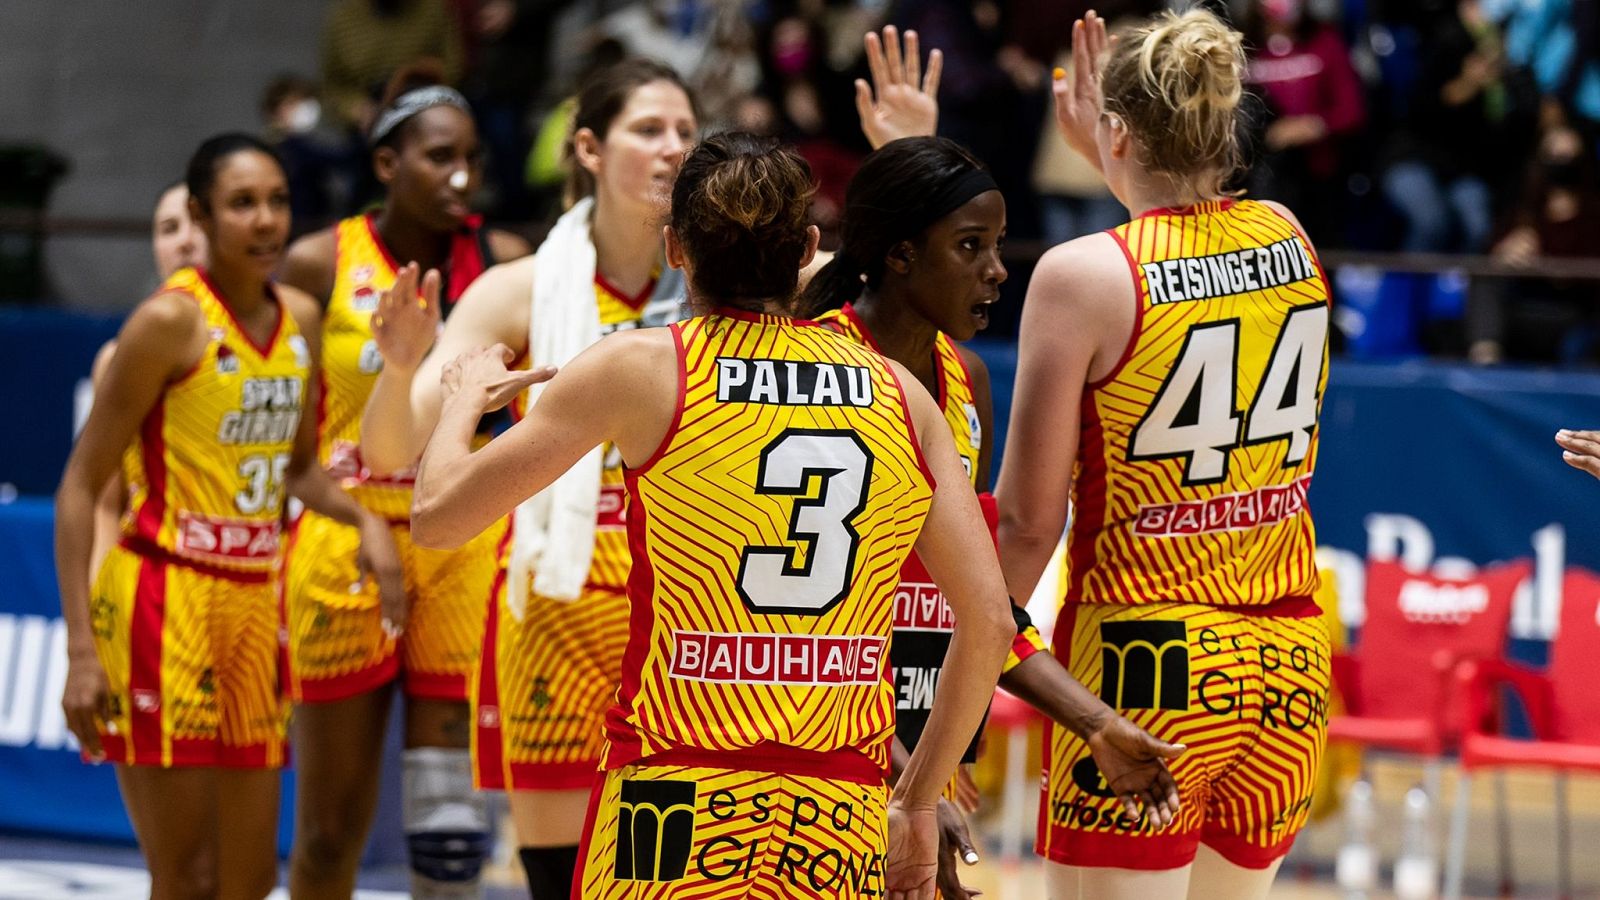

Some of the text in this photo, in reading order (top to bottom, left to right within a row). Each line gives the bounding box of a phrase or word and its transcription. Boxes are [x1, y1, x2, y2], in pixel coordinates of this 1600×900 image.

[716, 358, 874, 407] PALAU
[1126, 300, 1328, 486] 44
[186, 519, 281, 557] SPA
[735, 428, 875, 616] 3
[677, 638, 881, 678] BAUHAUS
[1199, 628, 1321, 681] espai
[1197, 670, 1328, 730] GIRON
[708, 789, 869, 836] espai
